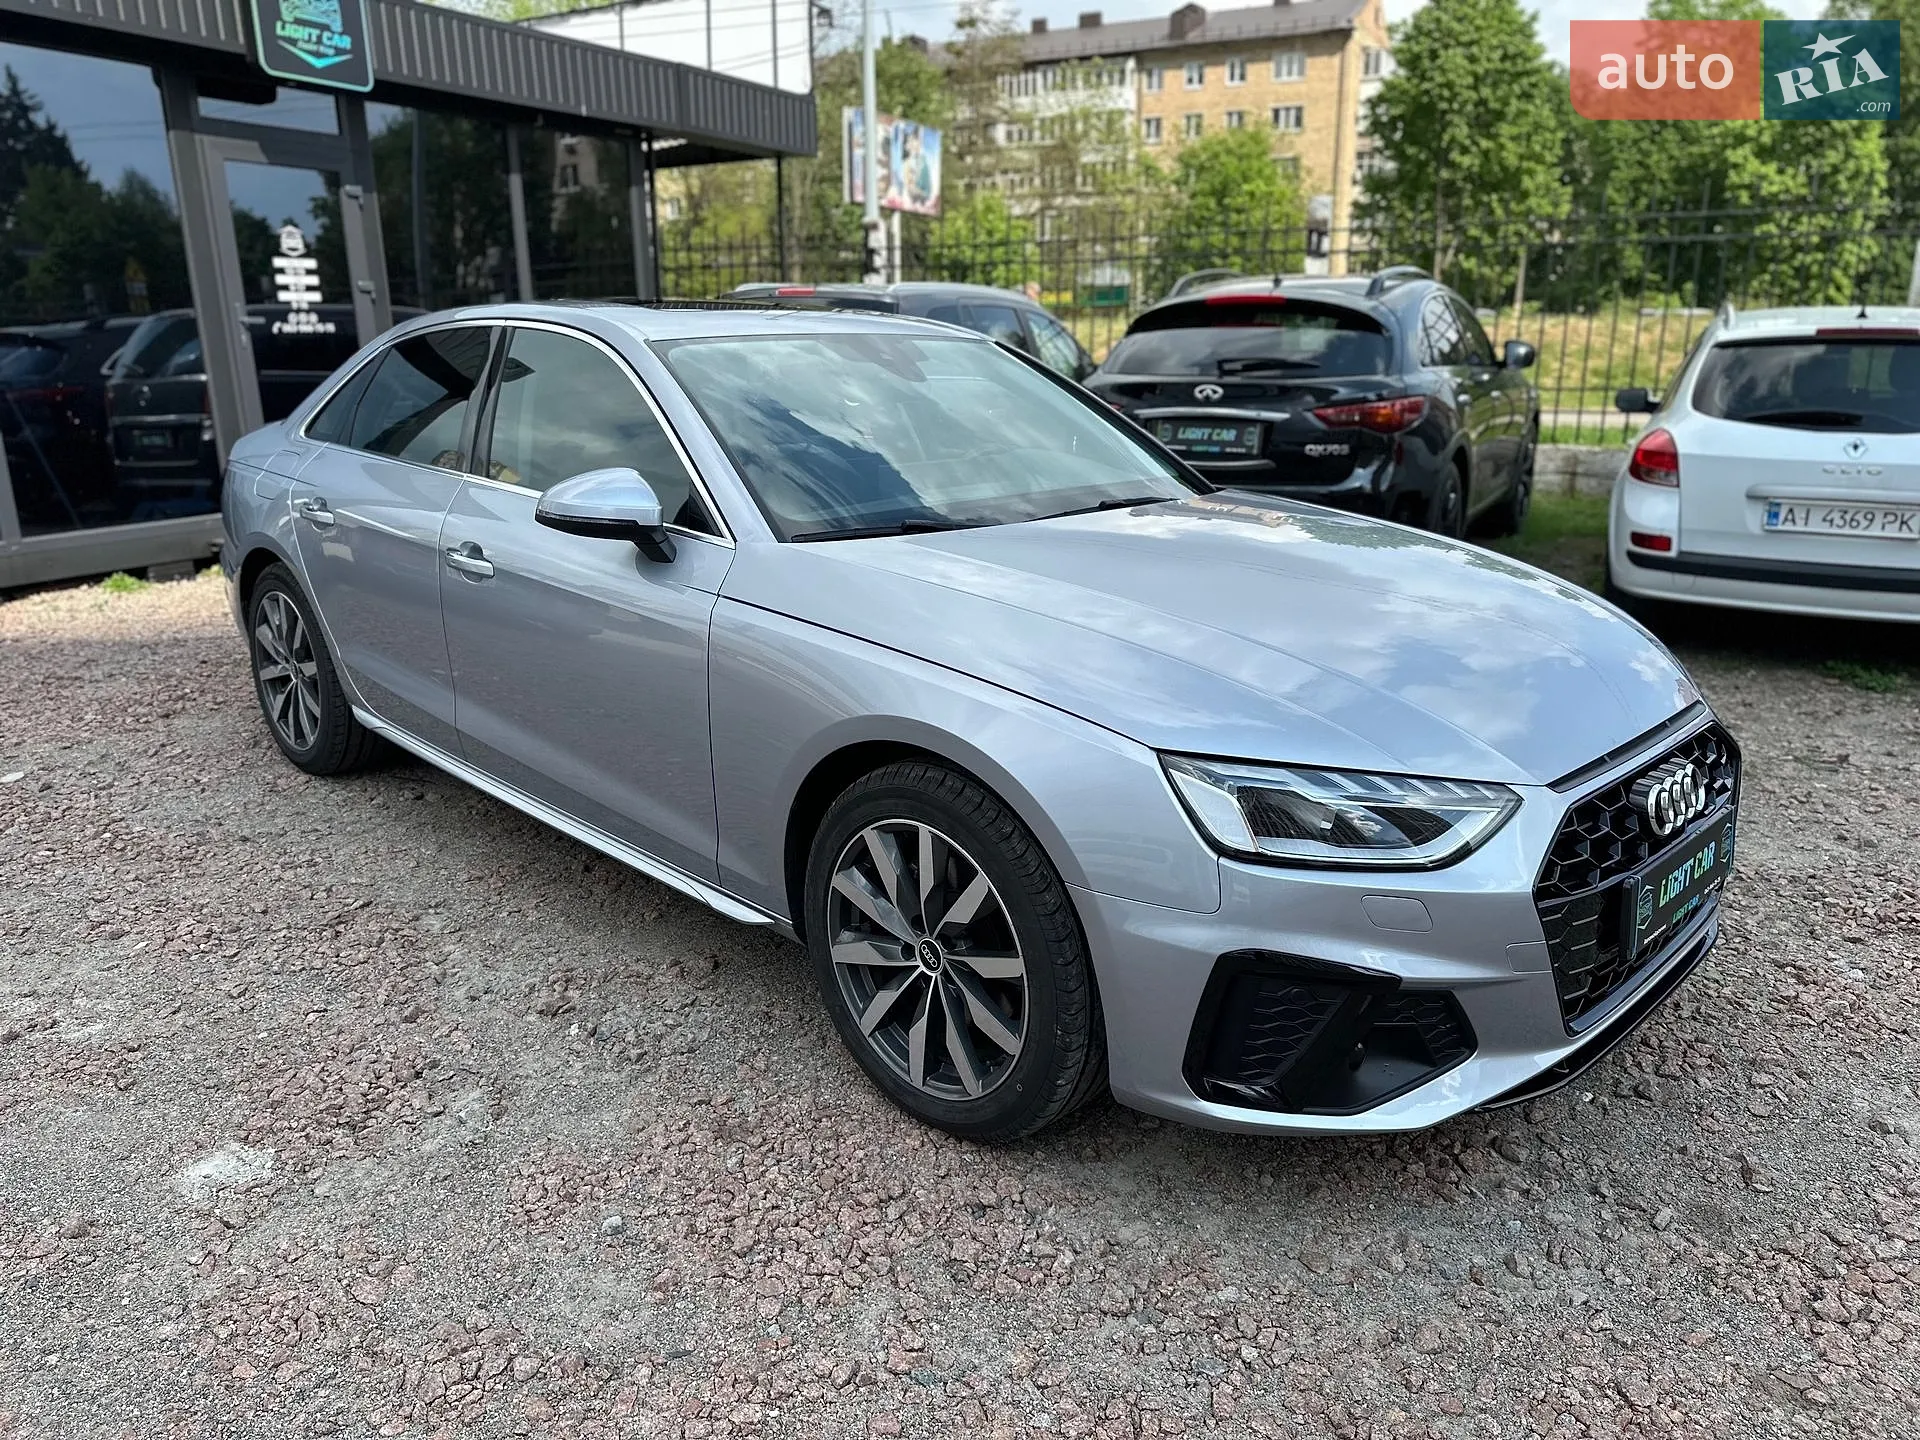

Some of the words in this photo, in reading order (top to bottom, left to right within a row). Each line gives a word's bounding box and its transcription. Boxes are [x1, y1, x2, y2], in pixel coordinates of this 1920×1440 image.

[275, 20, 320, 42] LIGHT
[322, 31, 352, 50] CAR
[1177, 427, 1213, 441] LIGHT
[1212, 428, 1238, 441] CAR
[1782, 507, 1811, 527] AI
[1821, 508, 1876, 531] 4369
[1881, 511, 1917, 533] PK
[1659, 857, 1695, 908] LIGHT
[1694, 841, 1716, 880] CAR
